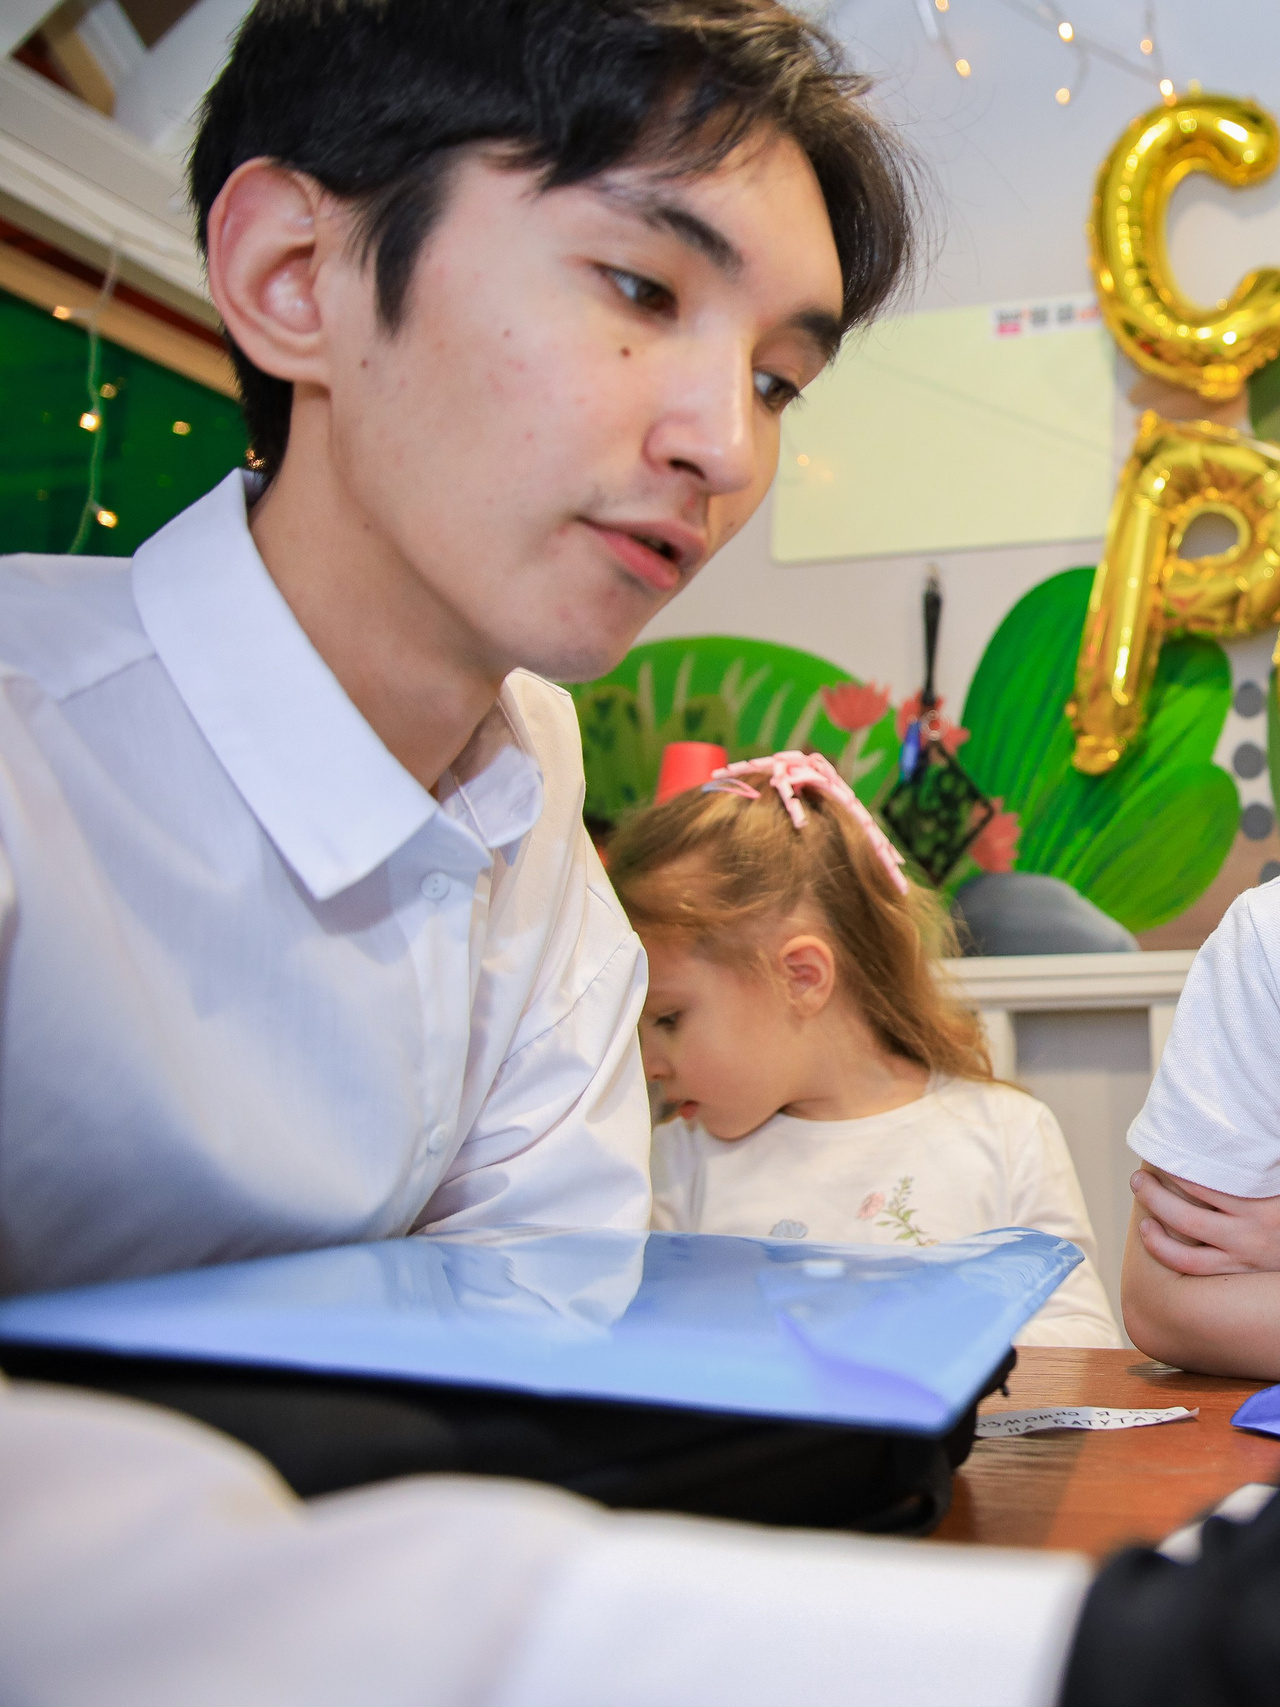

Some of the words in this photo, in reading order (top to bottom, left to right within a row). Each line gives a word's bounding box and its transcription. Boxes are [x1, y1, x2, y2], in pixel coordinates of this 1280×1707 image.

[976, 1411, 1080, 1430] ОЗМОЖНО
[1008, 1425, 1035, 1434] НА
[1052, 1415, 1164, 1427] БАТУТАХ
